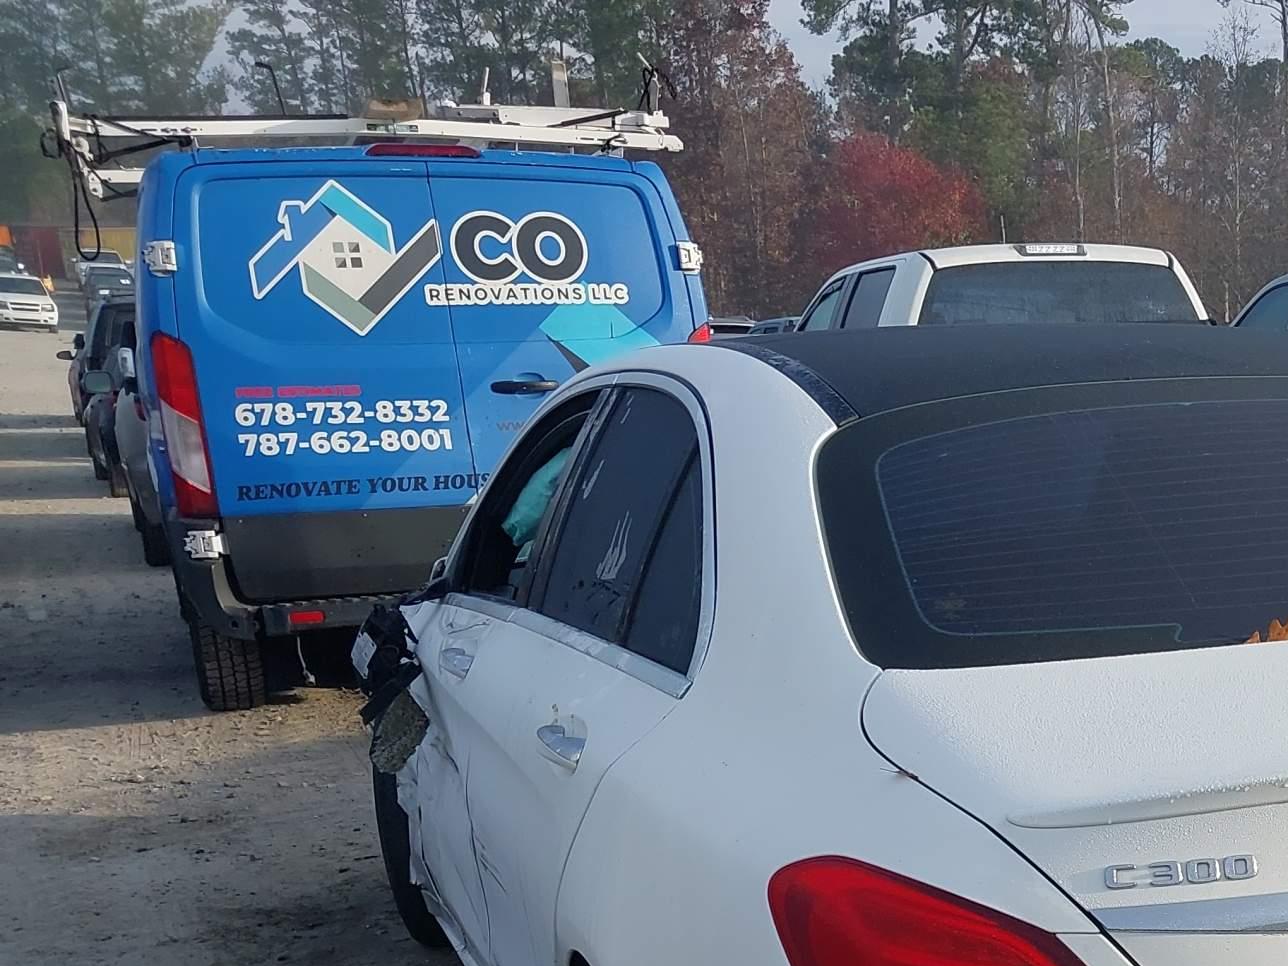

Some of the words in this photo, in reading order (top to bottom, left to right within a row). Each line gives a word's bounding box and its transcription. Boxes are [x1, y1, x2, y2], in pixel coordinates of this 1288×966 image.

[451, 211, 587, 283] CO
[428, 286, 583, 302] RENOVATIONS
[592, 286, 626, 300] LLC
[234, 400, 449, 427] 678-732-8332
[238, 428, 453, 457] 787-662-8001
[237, 479, 361, 502] RENOVATE
[366, 475, 429, 494] YOUR
